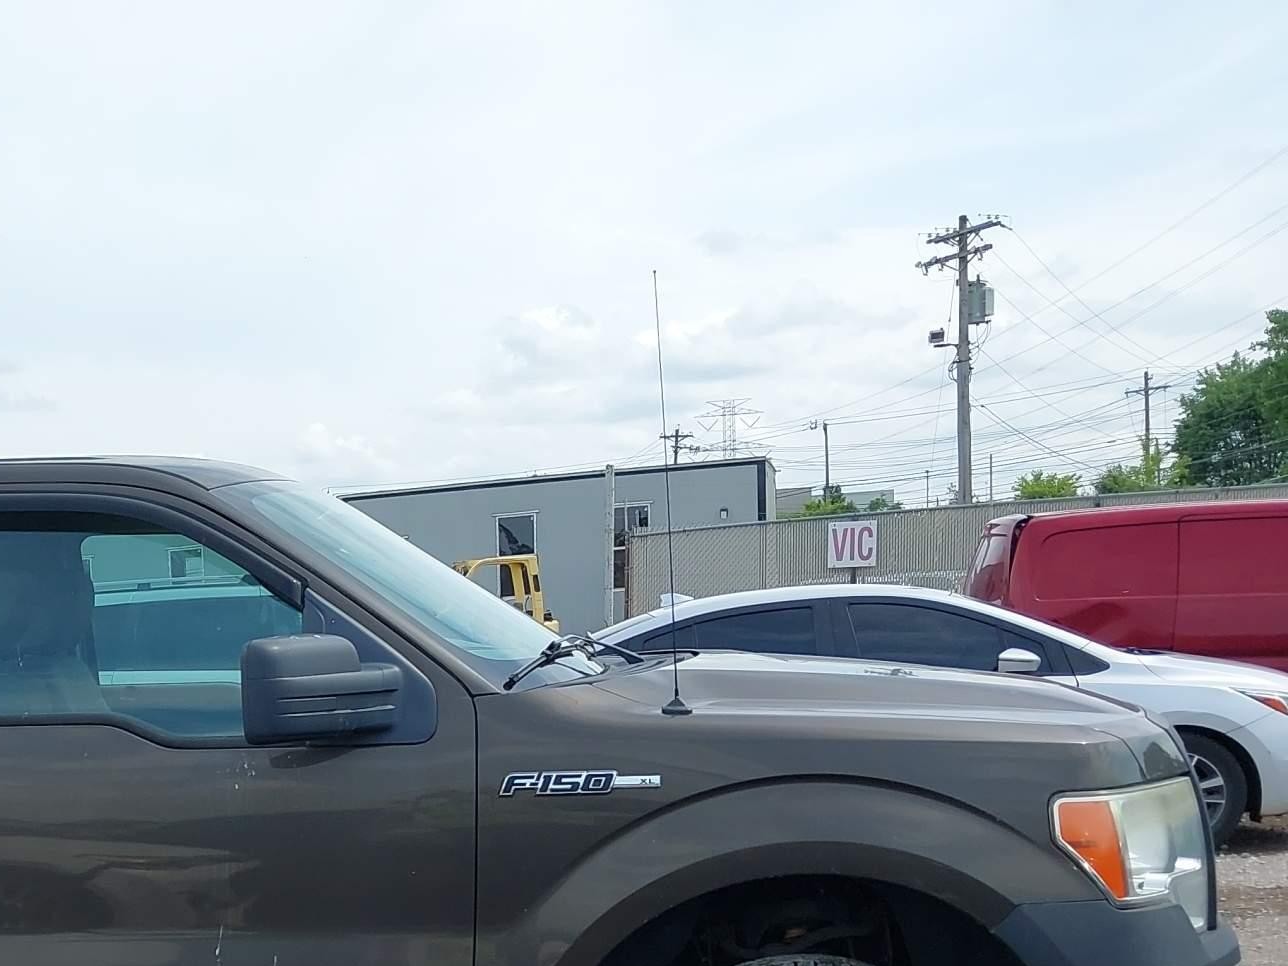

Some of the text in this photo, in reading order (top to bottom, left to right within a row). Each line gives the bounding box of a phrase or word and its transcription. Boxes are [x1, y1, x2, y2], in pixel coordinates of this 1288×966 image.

[832, 527, 873, 561] VIC
[499, 770, 656, 796] F-150 XL
